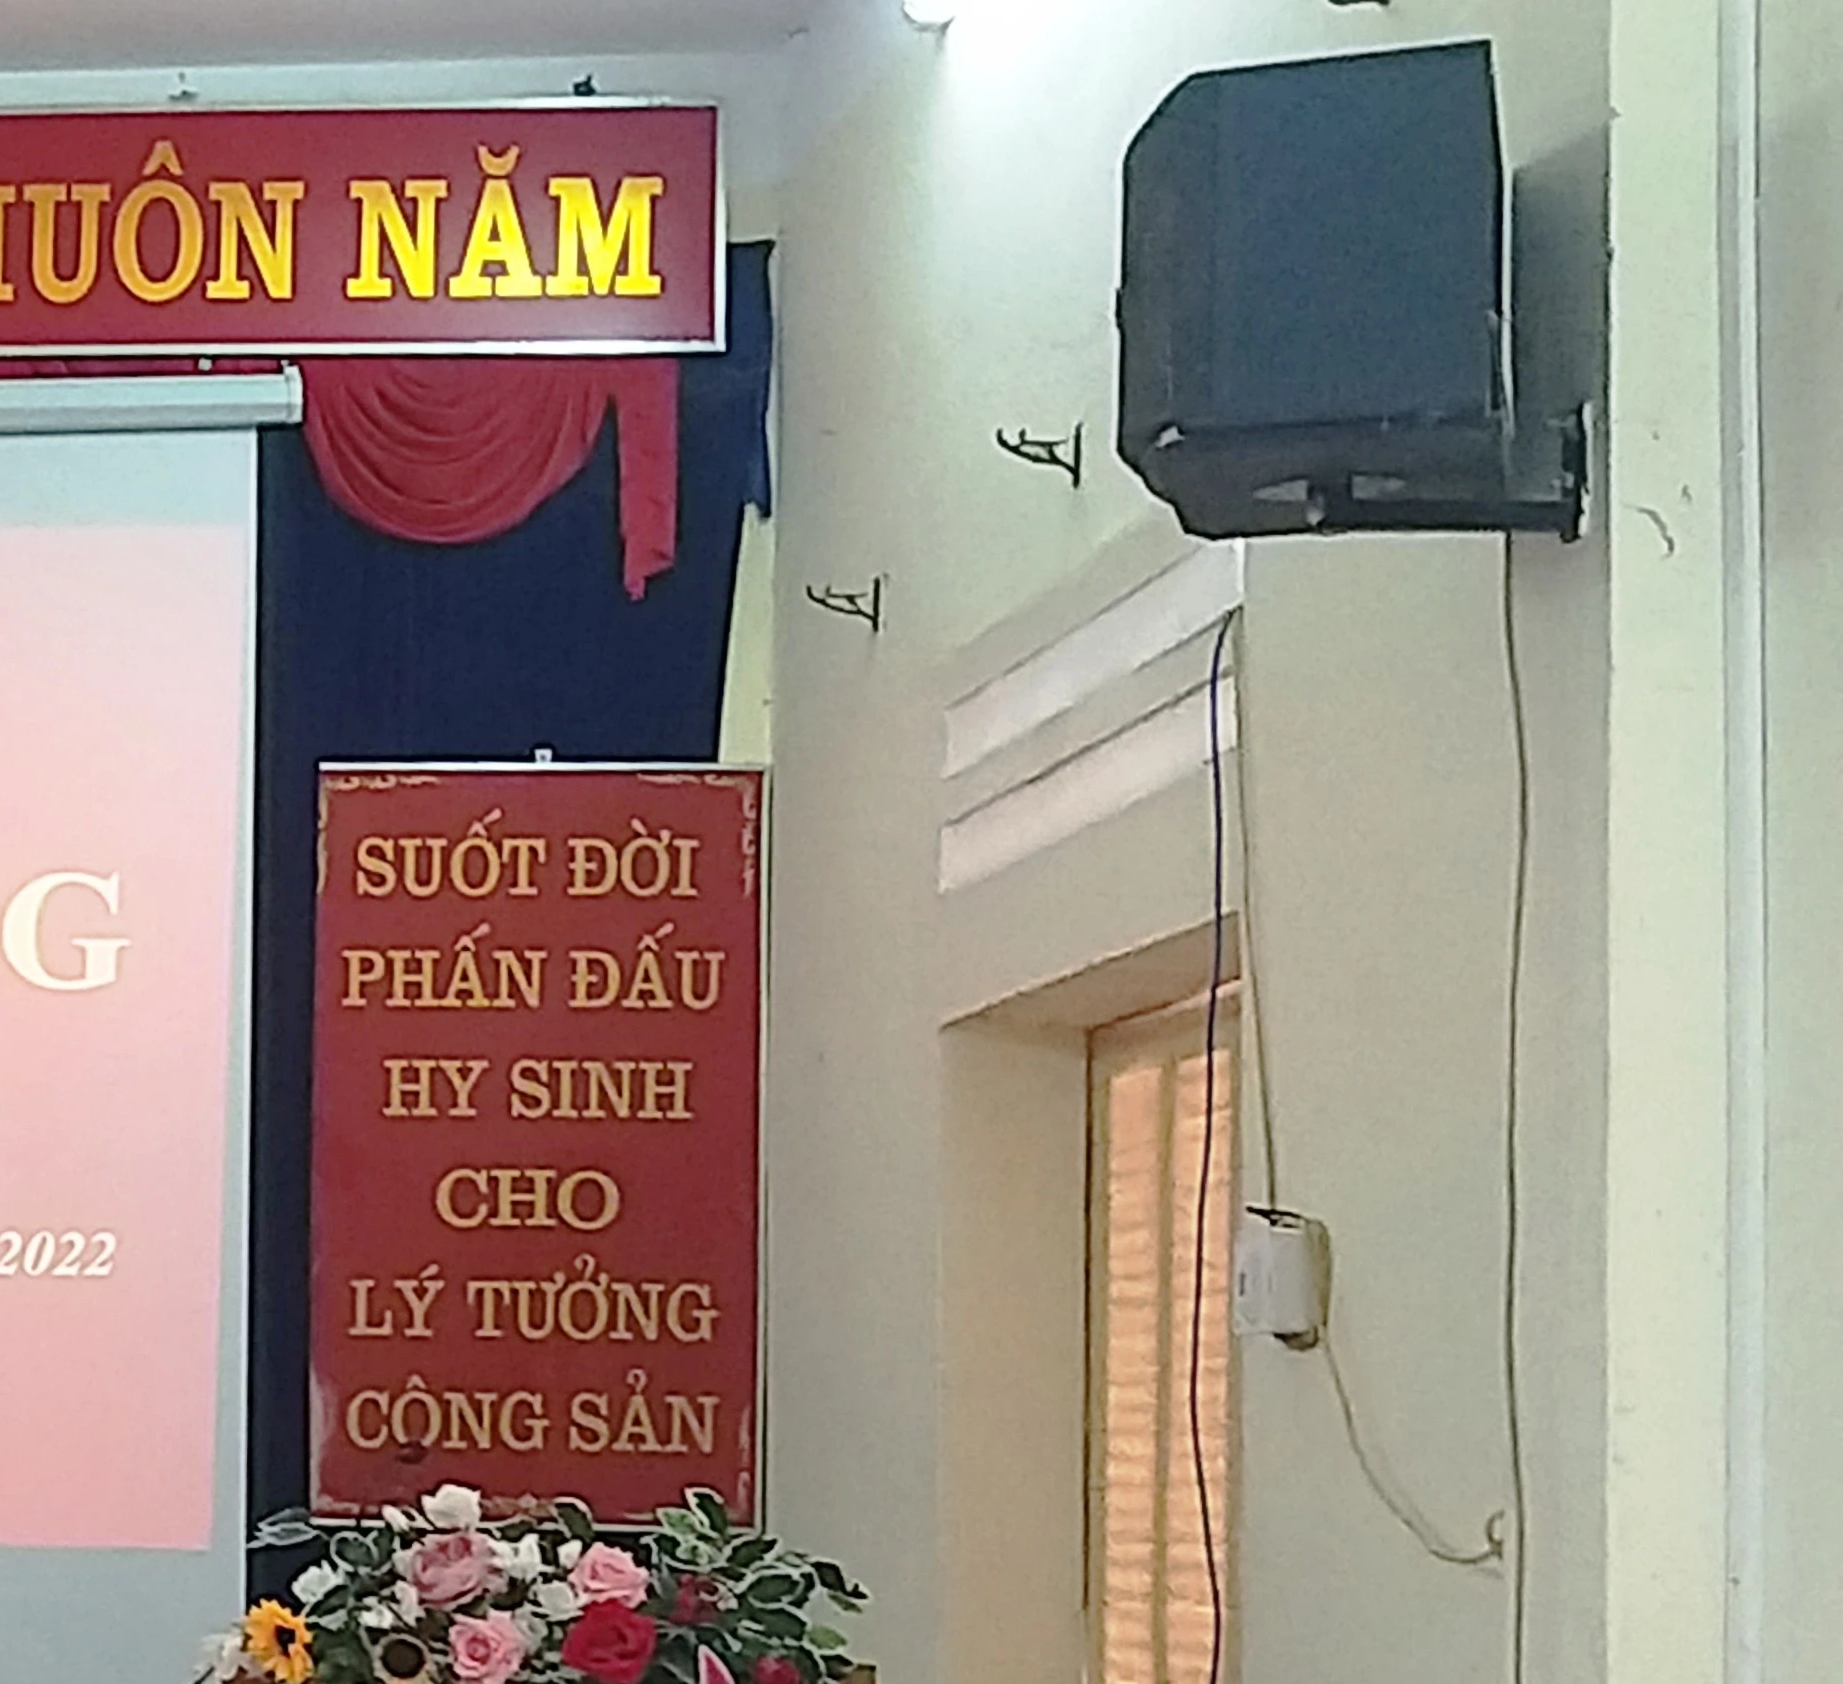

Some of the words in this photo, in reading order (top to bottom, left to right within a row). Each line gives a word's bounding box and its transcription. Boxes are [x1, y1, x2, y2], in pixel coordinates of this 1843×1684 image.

[347, 145, 661, 298] NĂM
[357, 809, 545, 896] SUỐT
[568, 819, 699, 896] ĐỜI
[342, 924, 547, 1007] PHẤN
[569, 923, 724, 1009] ĐẤU
[383, 1060, 489, 1115] HY
[511, 1060, 692, 1118] SINH
[436, 1169, 619, 1229] CHO
[349, 1265, 444, 1336] LÝ
[467, 1254, 718, 1341] TƯỞNG
[570, 1369, 719, 1452] SẢN
